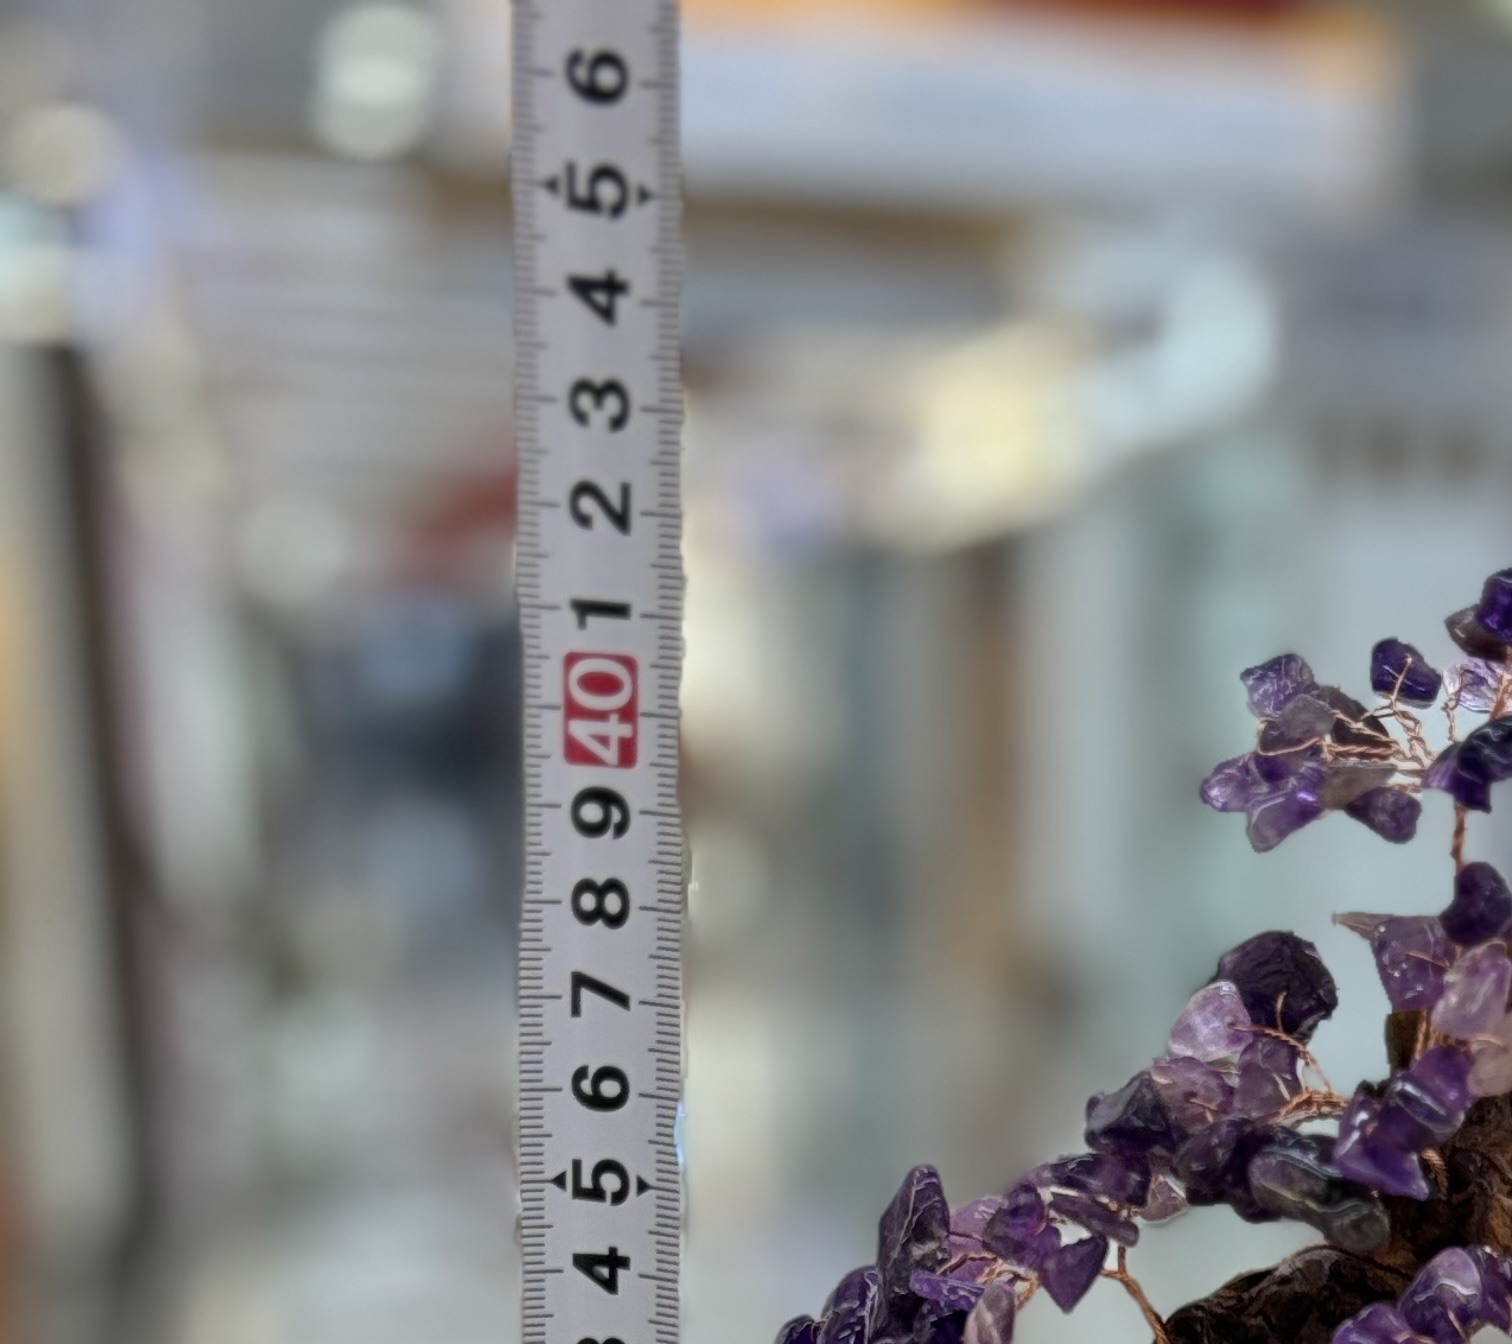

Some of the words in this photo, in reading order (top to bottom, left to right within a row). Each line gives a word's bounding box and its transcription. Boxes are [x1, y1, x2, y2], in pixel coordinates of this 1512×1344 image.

[565, 48, 629, 107] 6
[566, 162, 630, 220] 5
[567, 269, 630, 327] 4
[569, 377, 631, 434] 3
[569, 479, 631, 536] 2
[570, 598, 631, 630] 1
[567, 657, 633, 766] 40
[570, 785, 631, 841] 9
[570, 876, 631, 931] 8
[570, 970, 631, 1019] 7
[571, 1064, 630, 1114] 6
[571, 1157, 631, 1208] 5
[572, 1245, 631, 1297] 4
